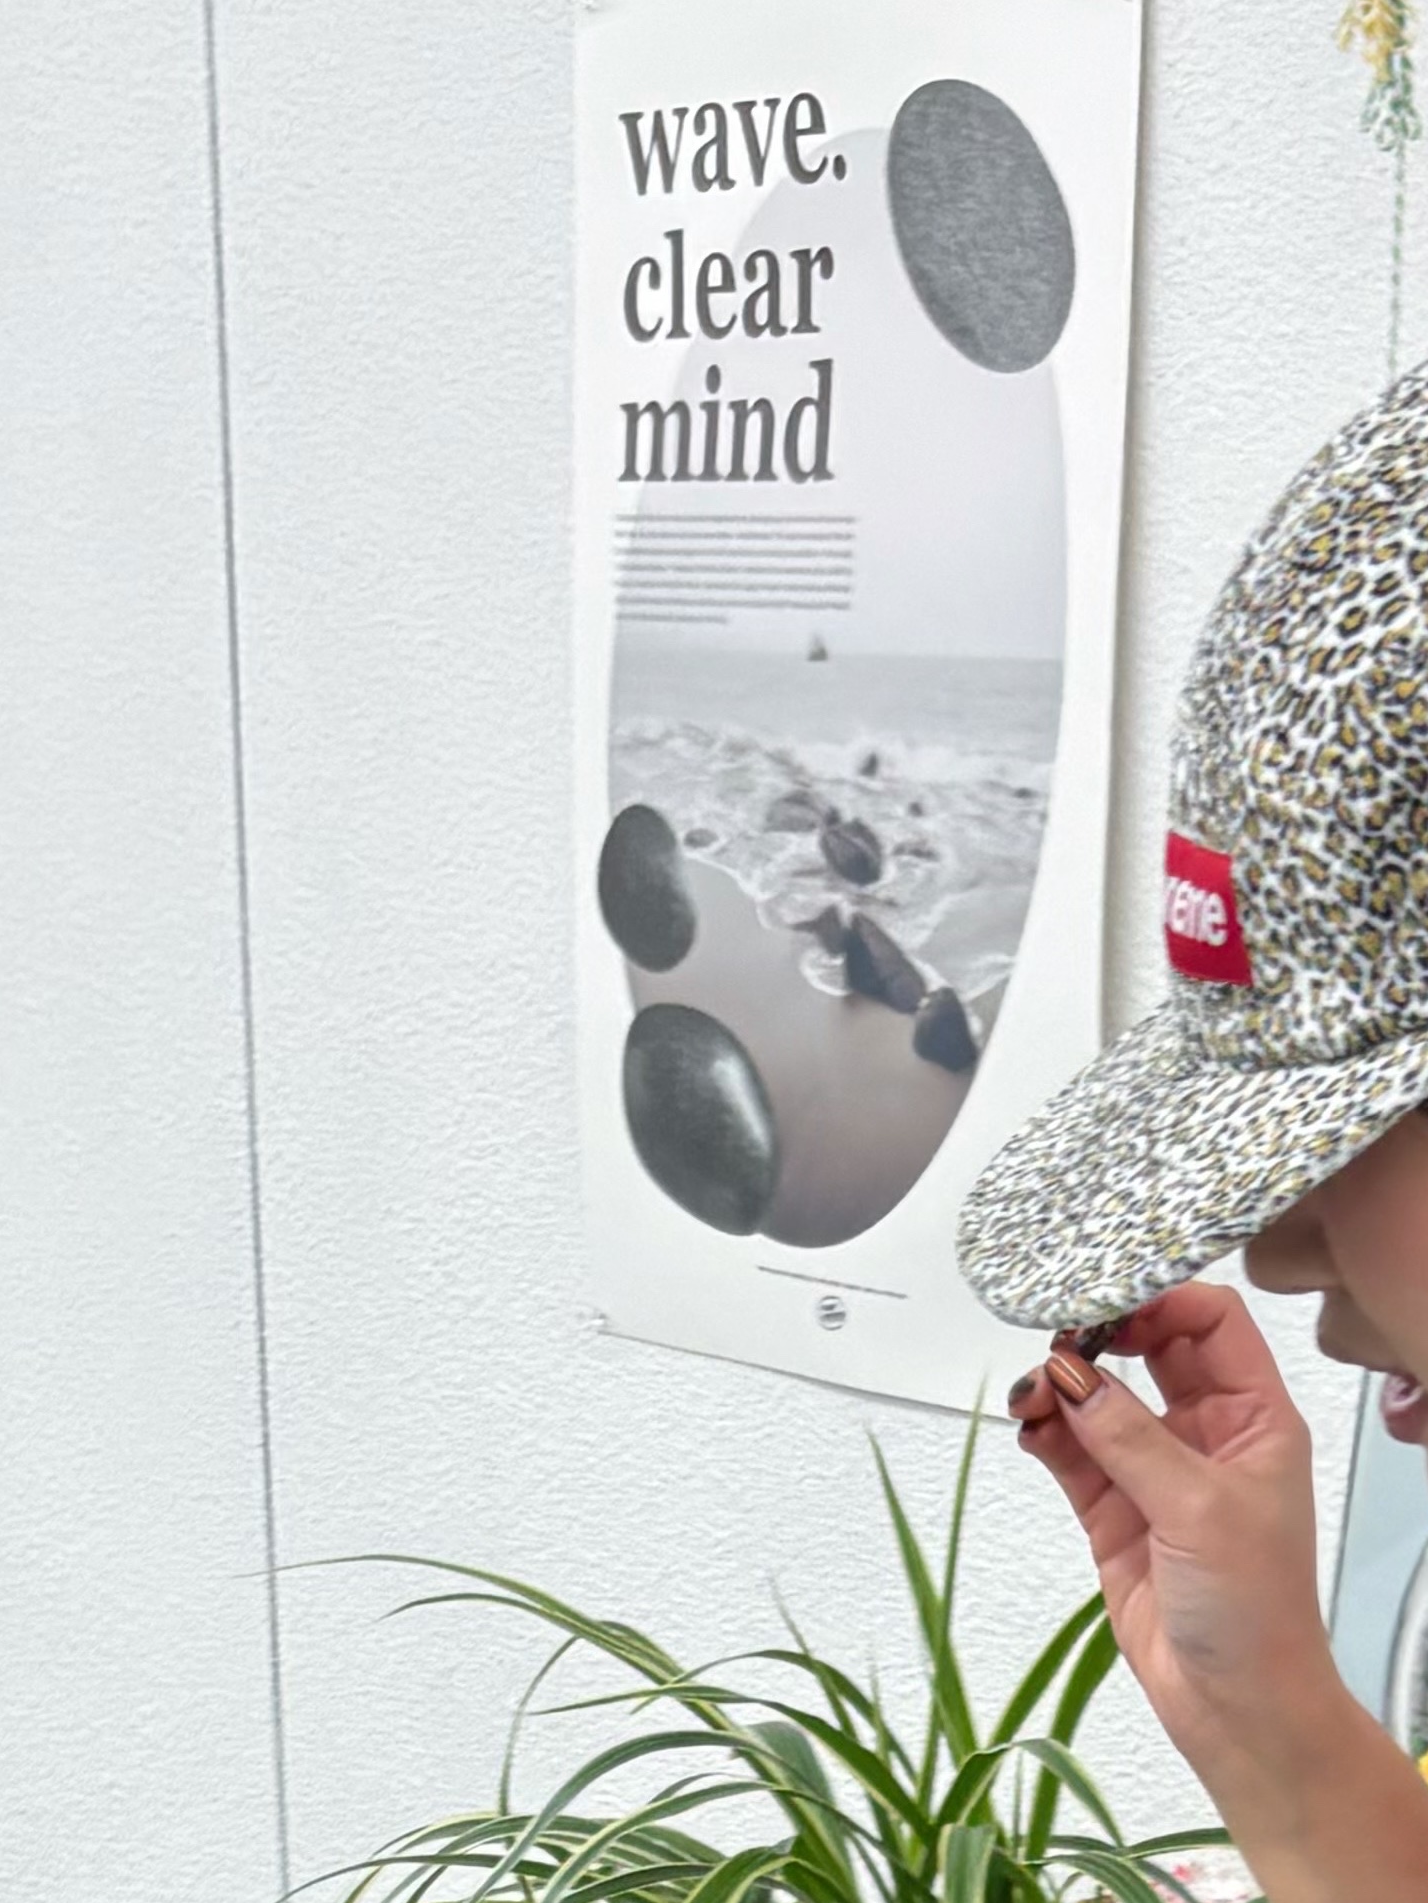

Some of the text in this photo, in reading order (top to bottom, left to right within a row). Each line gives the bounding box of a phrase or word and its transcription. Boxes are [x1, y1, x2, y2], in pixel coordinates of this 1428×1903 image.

[618, 92, 847, 195] wave.
[622, 228, 835, 343] clear
[618, 358, 835, 484] mind
